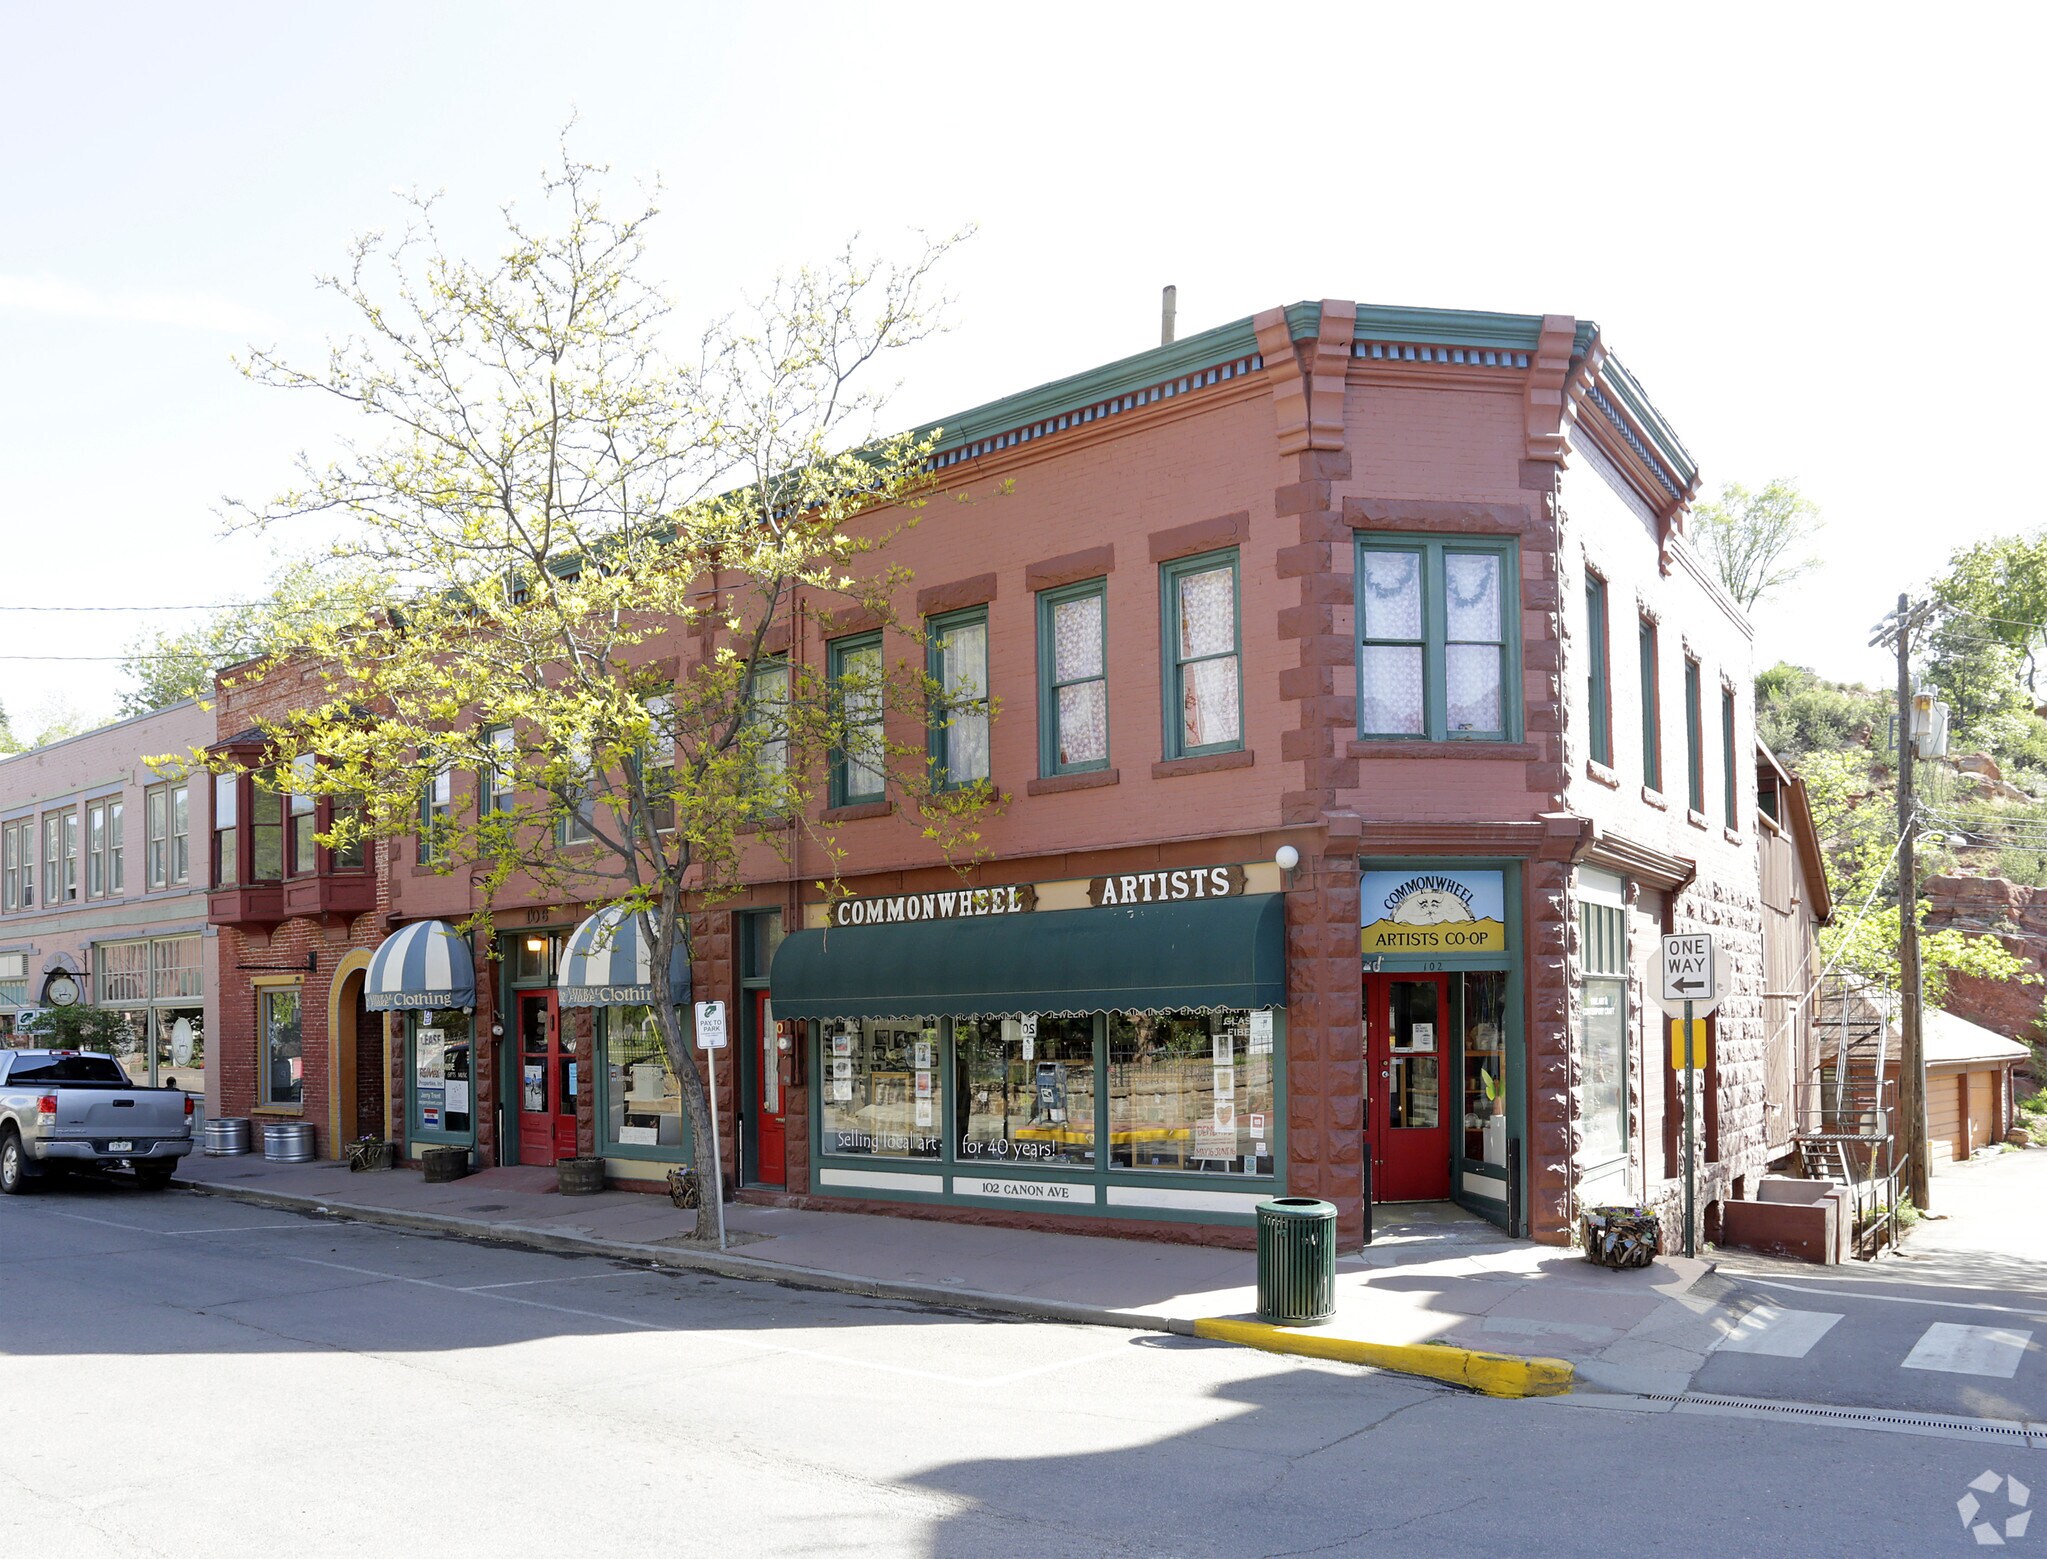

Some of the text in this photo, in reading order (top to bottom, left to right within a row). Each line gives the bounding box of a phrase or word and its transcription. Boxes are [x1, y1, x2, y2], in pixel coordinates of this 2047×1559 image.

[1101, 867, 1230, 904] ARTISTS
[1383, 876, 1475, 910] COMMONWHEEL
[837, 886, 1022, 926] COMMONWHEEL
[1376, 932, 1488, 946] ARTISTS CO-OP
[1669, 940, 1705, 955] ONE
[1423, 962, 1443, 971] 102
[1668, 957, 1705, 973] WAY
[393, 992, 452, 1007] Clothing
[600, 986, 653, 1002] Clothi
[1223, 1016, 1250, 1025] GLAS
[1228, 1028, 1250, 1036] FIBE
[838, 1129, 937, 1153] Selling local art
[962, 1133, 1056, 1161] for 40 years!
[982, 1182, 1069, 1198] 102 CANON AVE
